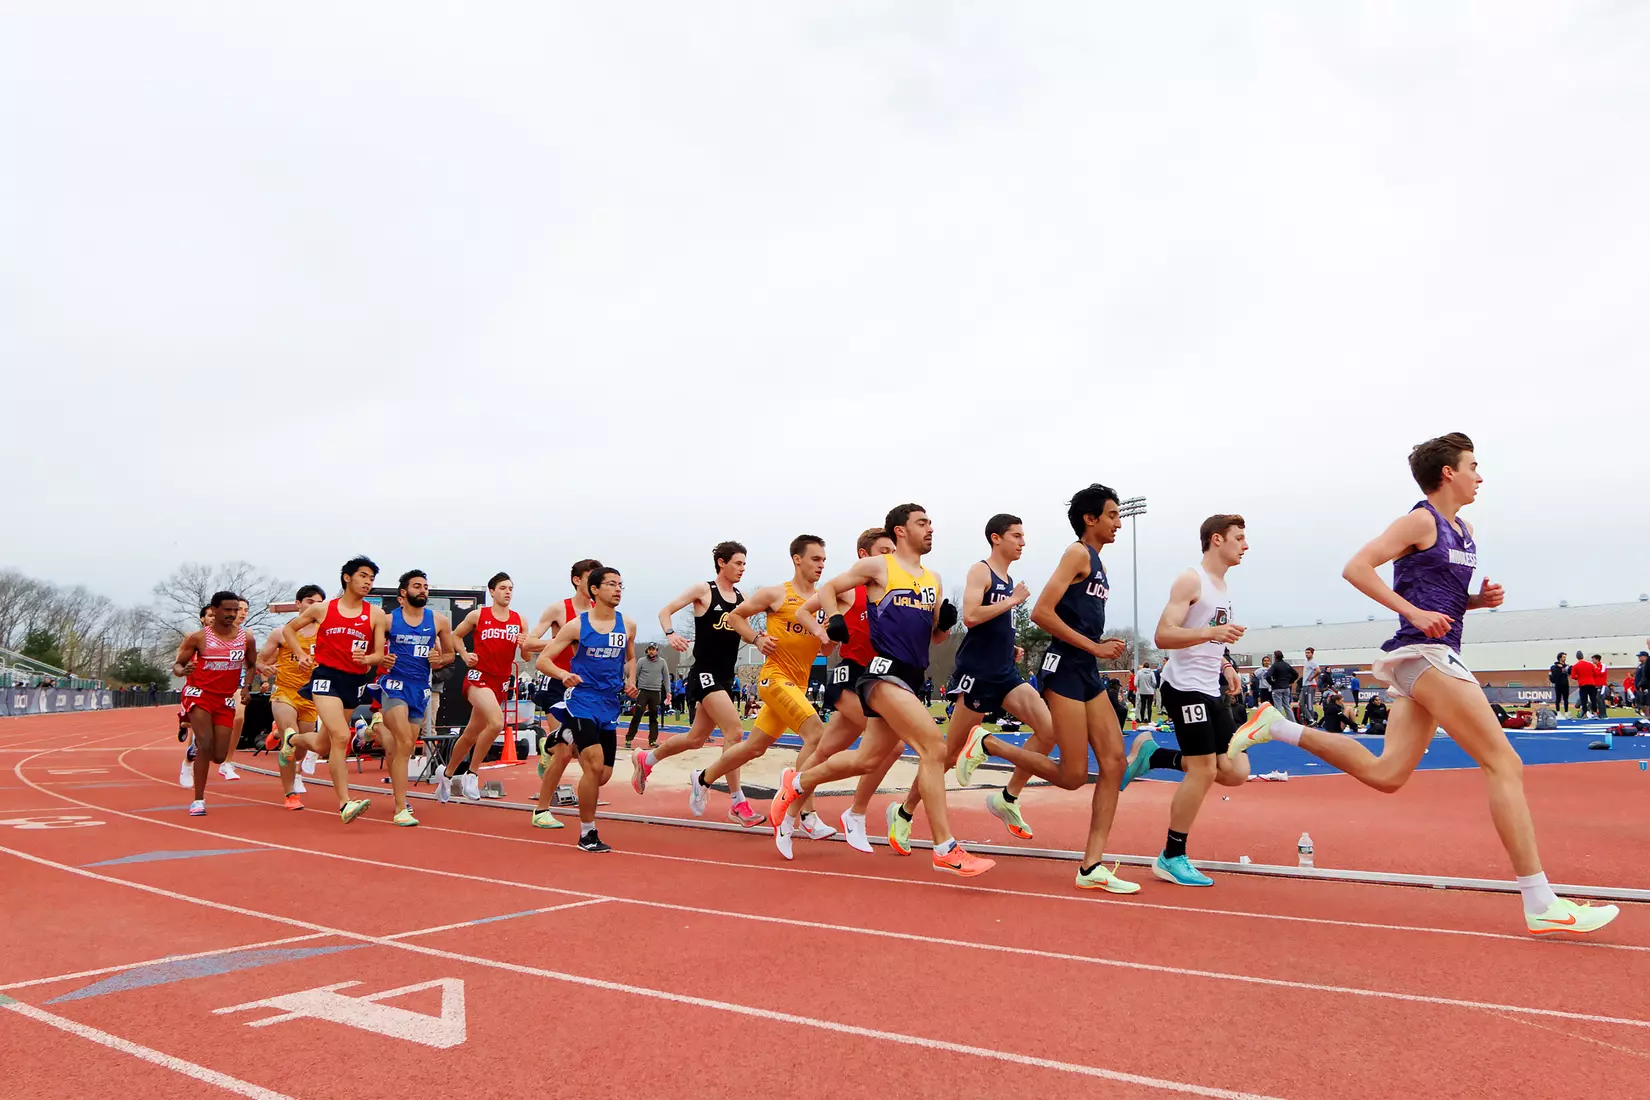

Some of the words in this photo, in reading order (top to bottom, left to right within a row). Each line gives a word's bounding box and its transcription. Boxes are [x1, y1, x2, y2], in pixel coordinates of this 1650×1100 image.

[922, 588, 936, 603] 15
[325, 626, 347, 636] STONY
[347, 628, 366, 640] BROOK
[507, 625, 519, 635] 23
[396, 634, 431, 645] CCSU
[611, 634, 624, 647] 18
[231, 650, 244, 661] 22
[417, 646, 428, 657] 12
[585, 647, 621, 658] CCSU
[873, 657, 890, 674] 15
[1045, 654, 1057, 670] 17
[469, 670, 480, 680] 23
[702, 674, 712, 686] 3
[836, 668, 847, 682] 16
[314, 680, 328, 691] 14
[389, 680, 401, 690] 12
[186, 687, 199, 696] 22
[1358, 691, 1379, 700] CONN
[1518, 691, 1552, 700] UCONN
[1184, 705, 1204, 722] 19
[211, 977, 468, 1050] 4
